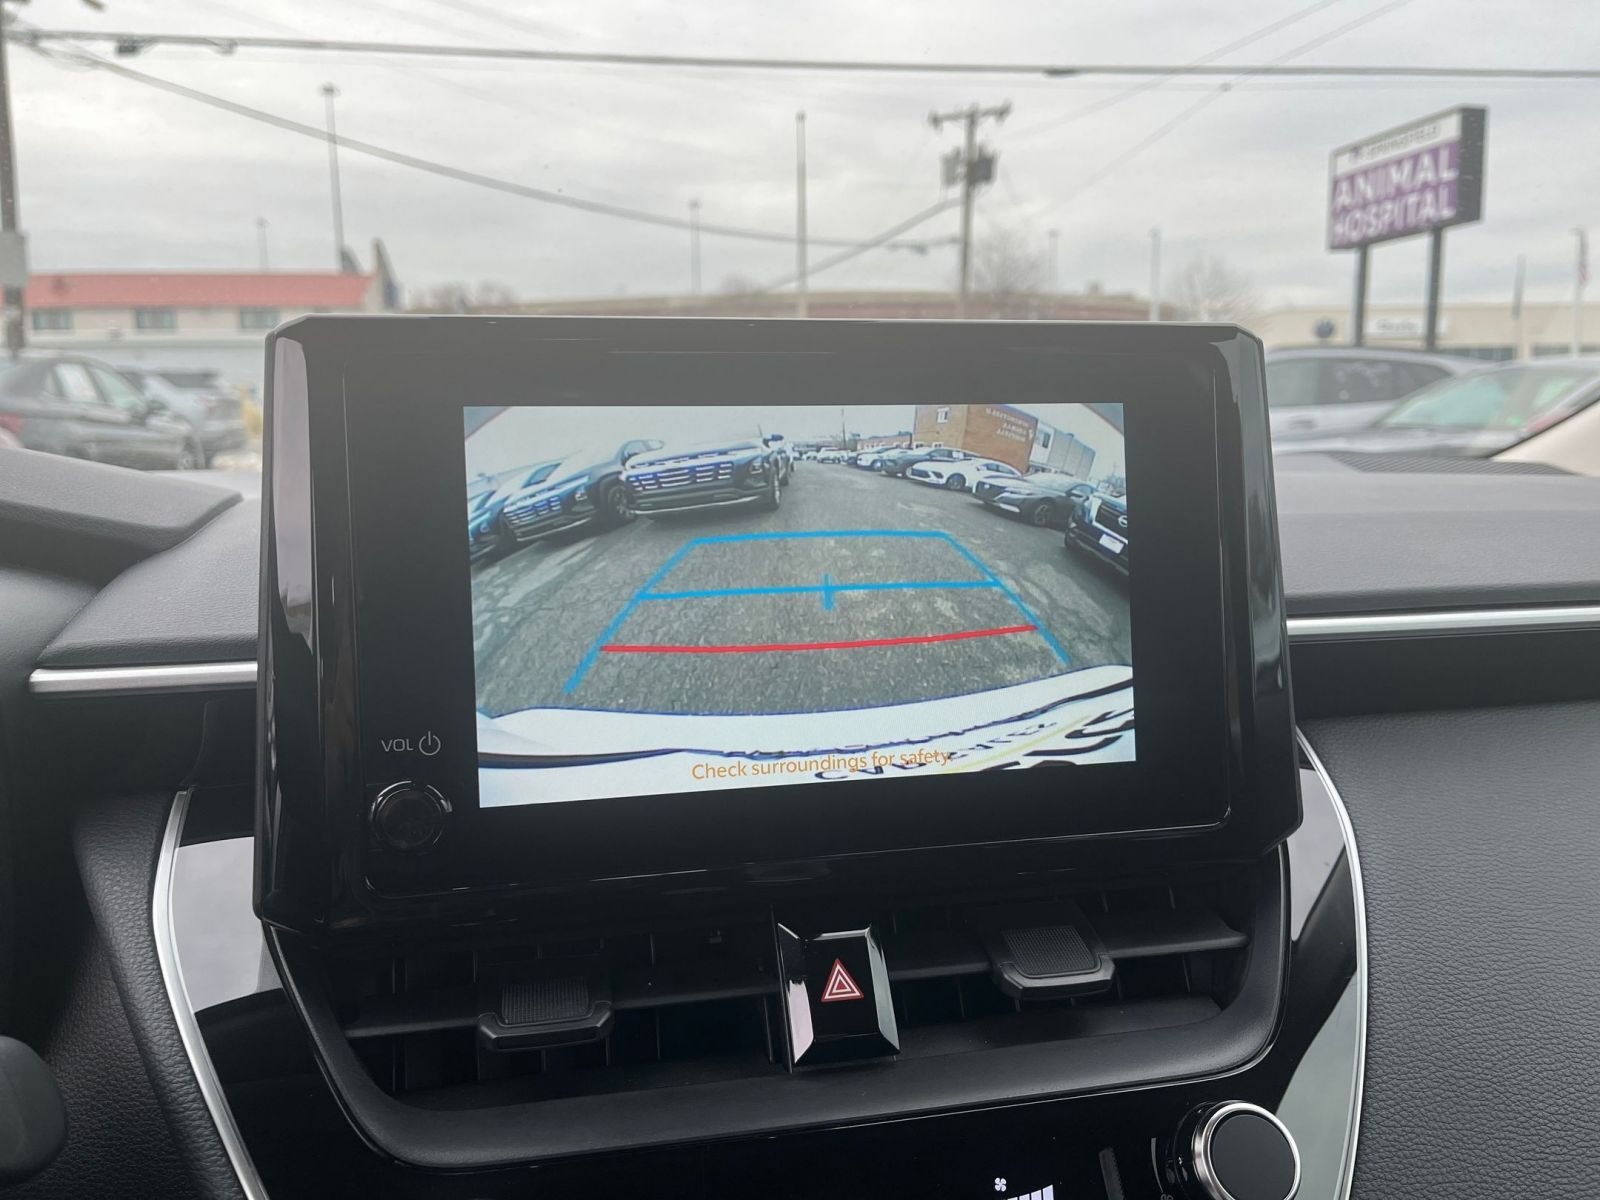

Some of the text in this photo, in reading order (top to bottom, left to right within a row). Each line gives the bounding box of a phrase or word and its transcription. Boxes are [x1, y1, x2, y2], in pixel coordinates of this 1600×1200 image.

[1334, 145, 1459, 213] ANIMAL
[1331, 184, 1457, 246] HOSPITAL
[380, 738, 414, 753] VOL
[691, 760, 748, 780] Check
[751, 753, 868, 776] surroundings
[871, 750, 896, 767] for
